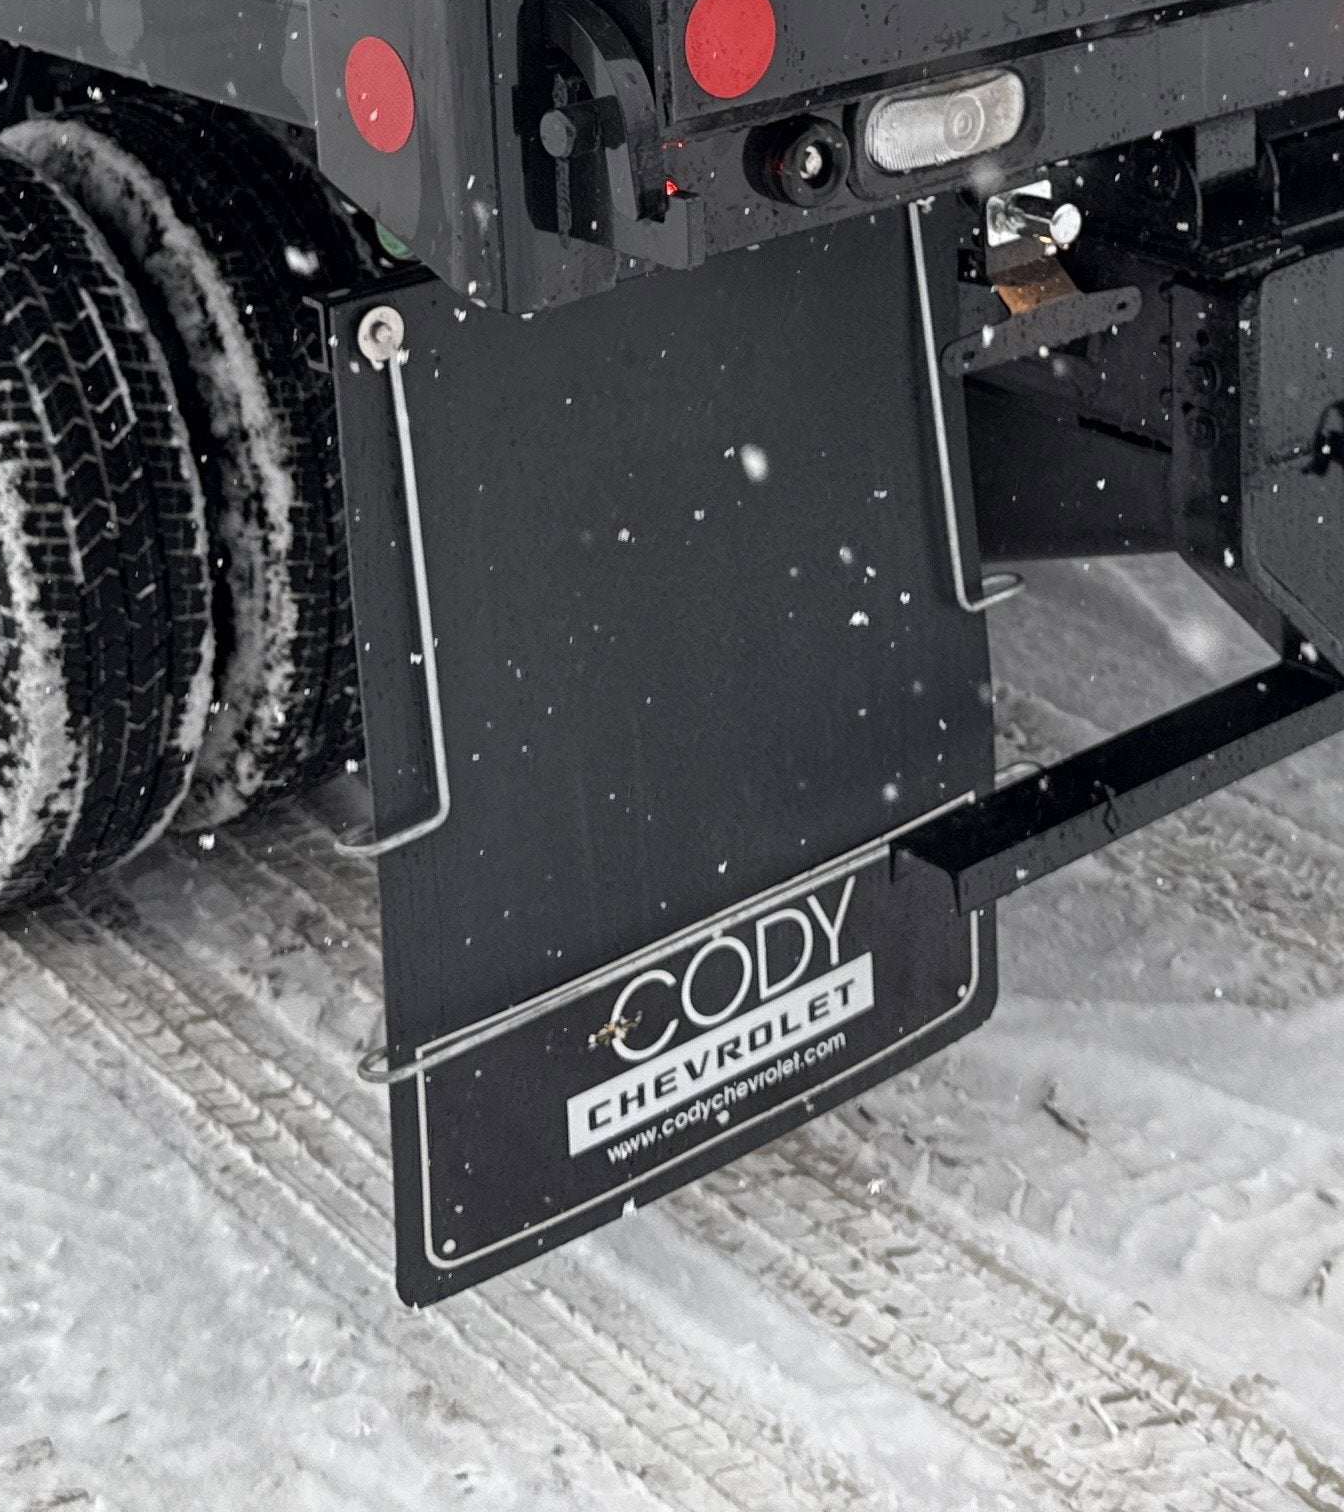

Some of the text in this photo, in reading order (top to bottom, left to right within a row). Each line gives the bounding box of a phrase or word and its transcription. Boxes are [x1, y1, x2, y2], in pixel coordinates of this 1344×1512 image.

[609, 874, 856, 1063] CODY
[587, 977, 856, 1132] CHEVROLET
[606, 1031, 847, 1165] www.codychevrolet.com
